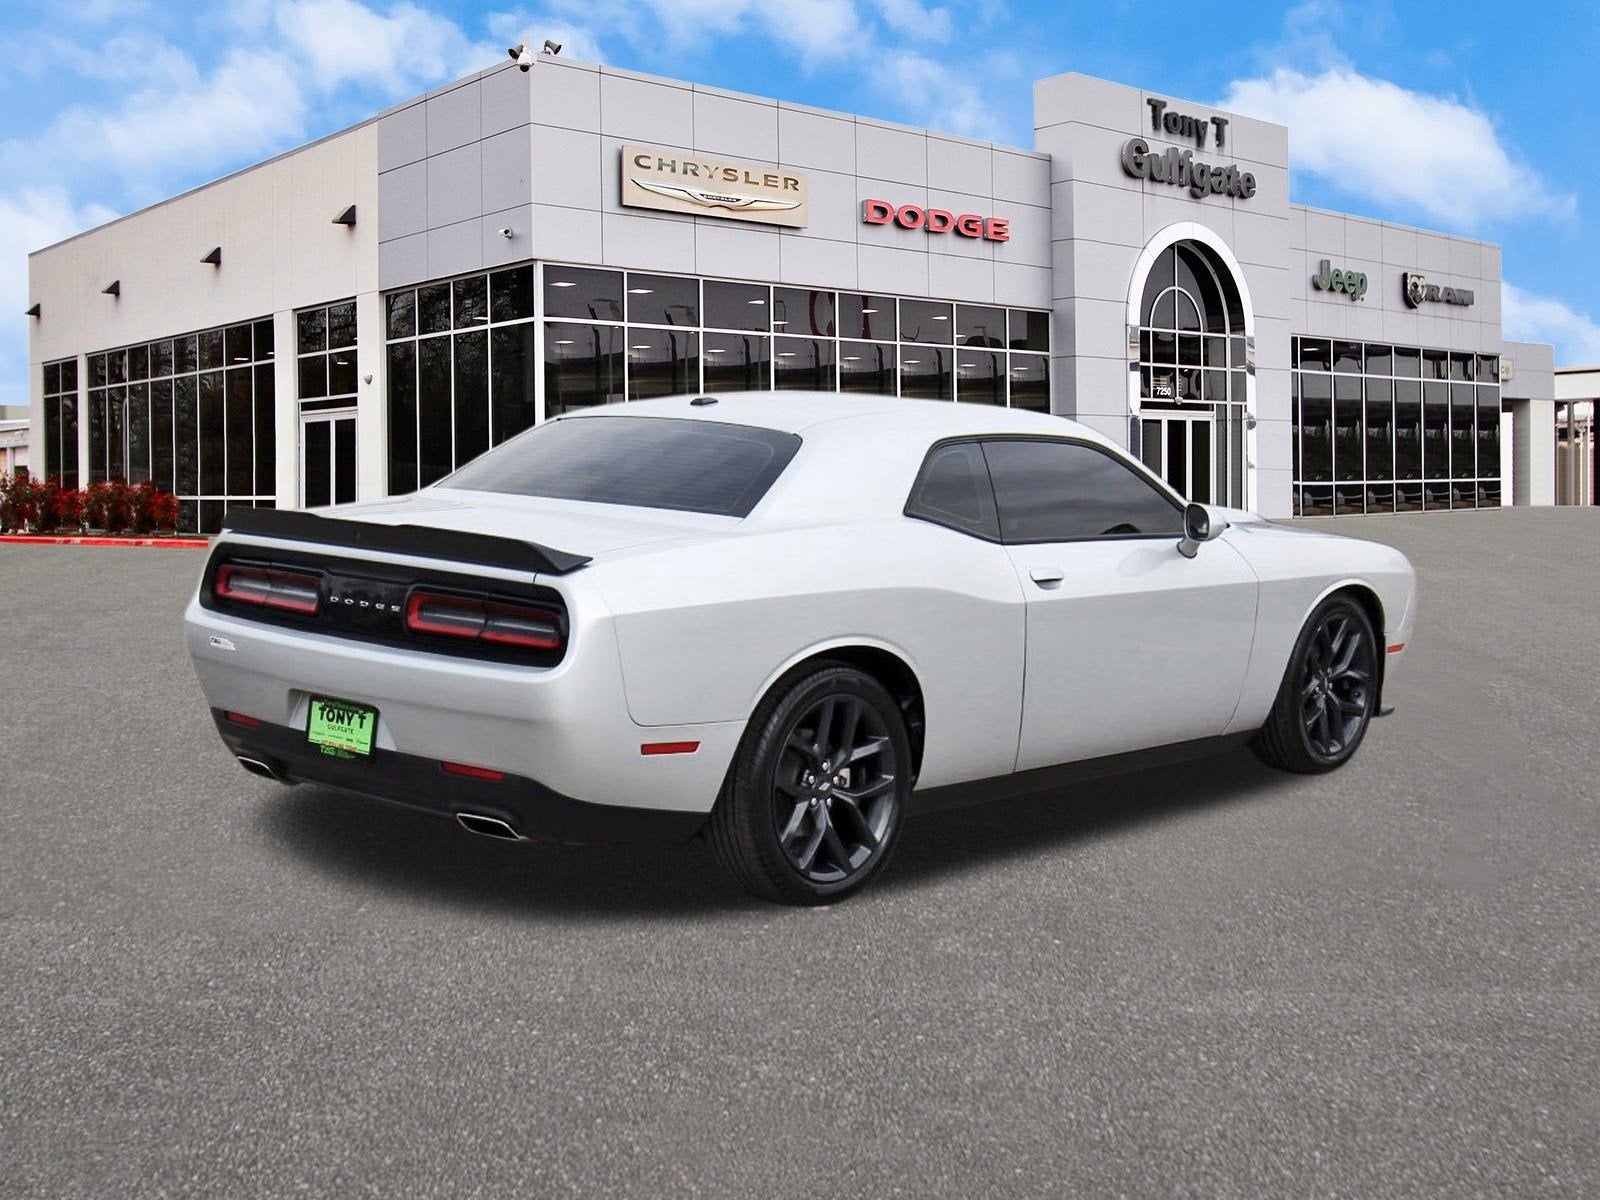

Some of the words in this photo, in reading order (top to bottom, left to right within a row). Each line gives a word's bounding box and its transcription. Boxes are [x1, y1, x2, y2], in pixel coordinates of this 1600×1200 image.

[1146, 97, 1208, 149] Tony
[1210, 116, 1229, 148] T
[633, 154, 800, 192] CHRYSLER
[1121, 138, 1257, 200] Gulfgate
[862, 199, 1010, 242] DODGE
[1312, 259, 1368, 302] Jeep
[1424, 283, 1475, 306] RAM
[329, 596, 401, 613] DODGE
[318, 706, 355, 727] TONY
[358, 711, 367, 729] T
